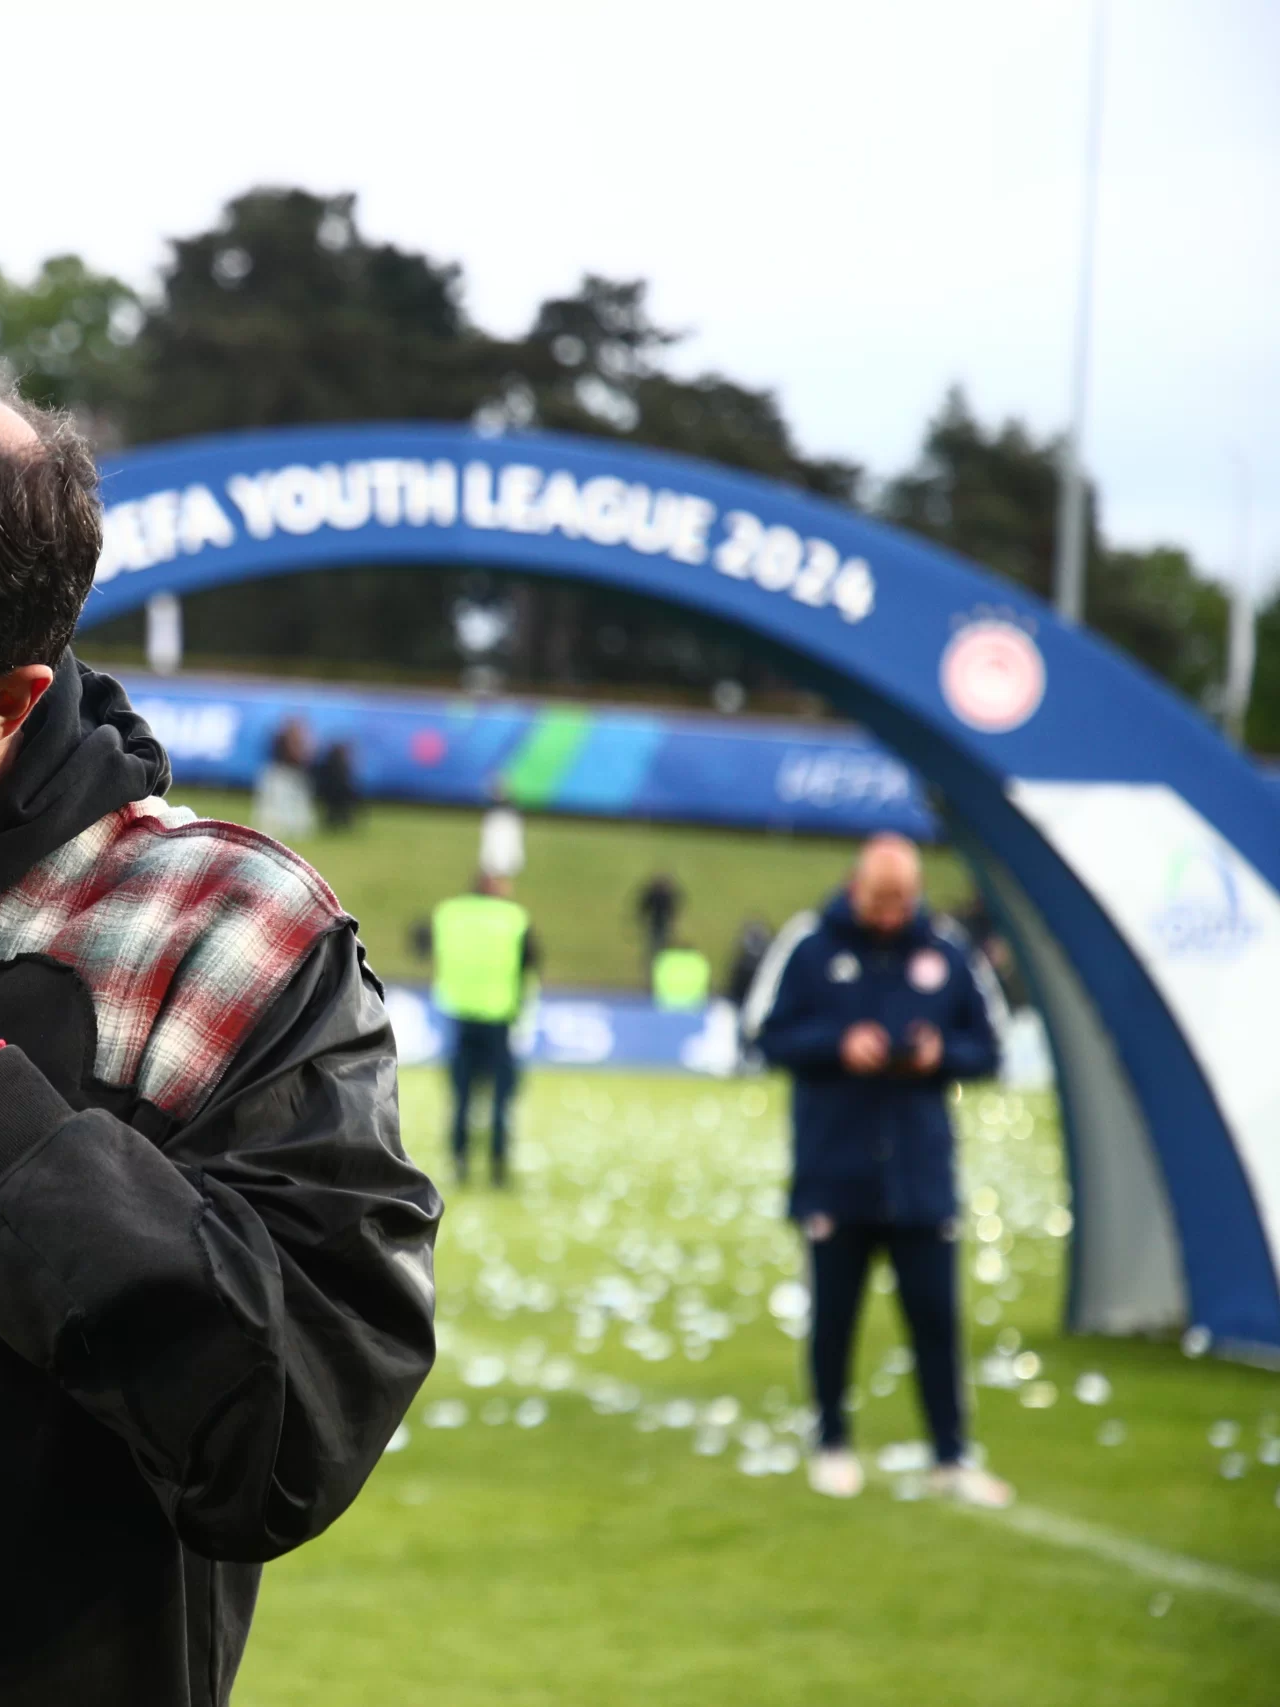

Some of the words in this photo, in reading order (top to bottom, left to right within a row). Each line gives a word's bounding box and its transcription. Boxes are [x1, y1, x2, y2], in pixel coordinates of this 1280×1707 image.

[228, 459, 457, 539] YOUTH
[463, 462, 715, 564] LEAGUE
[715, 511, 874, 623] 2024
